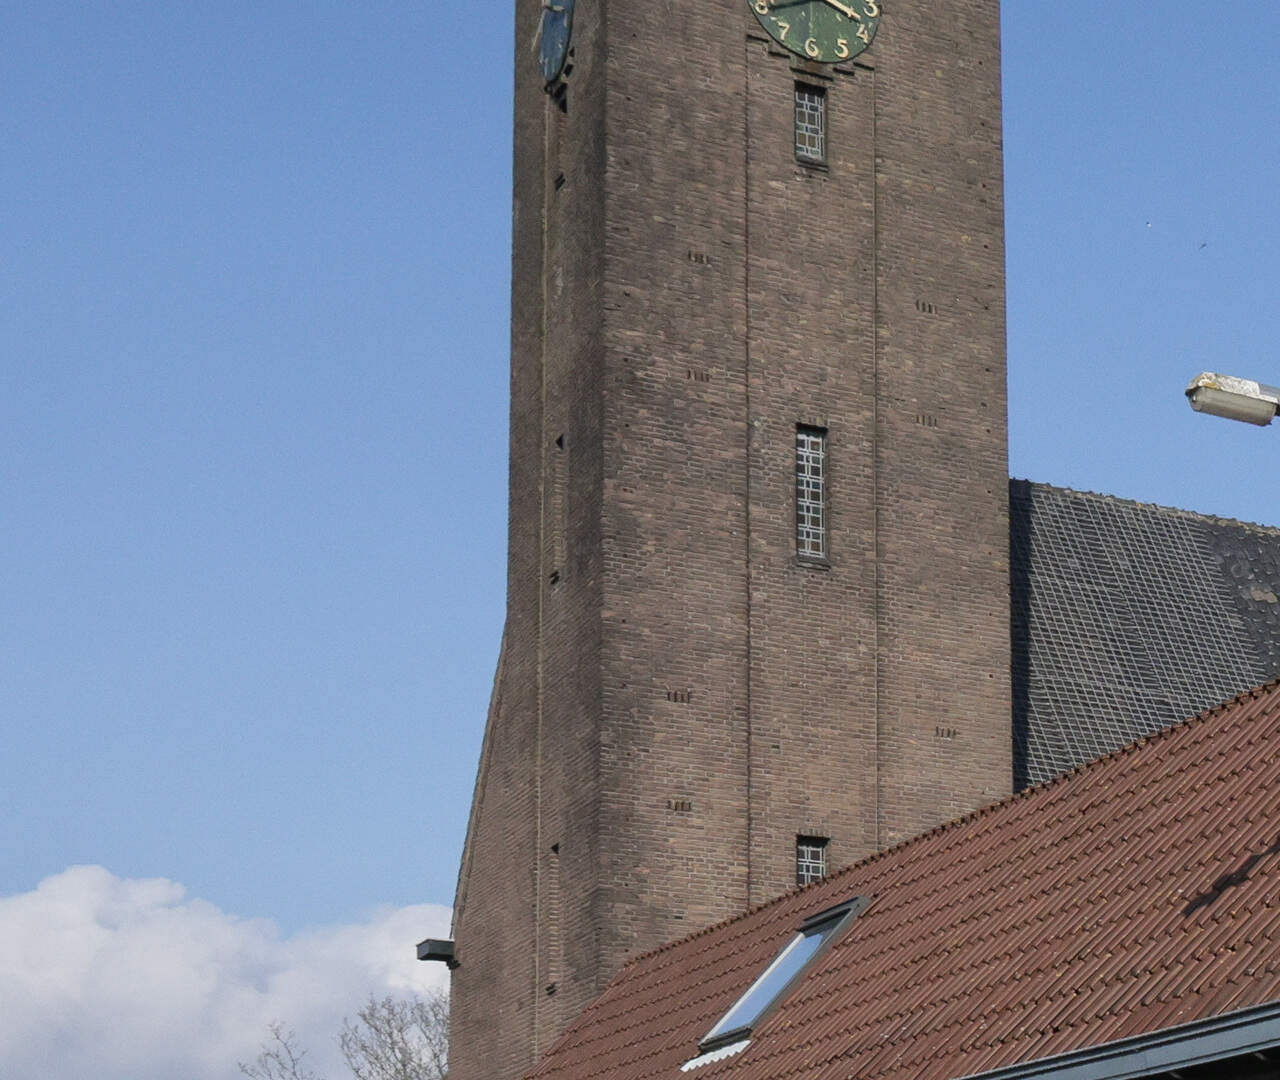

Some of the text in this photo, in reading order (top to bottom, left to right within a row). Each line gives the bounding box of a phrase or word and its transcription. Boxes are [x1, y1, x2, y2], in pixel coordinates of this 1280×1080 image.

[776, 20, 790, 41] 7
[856, 23, 869, 43] 4
[804, 37, 819, 57] 6
[834, 38, 849, 58] 5
